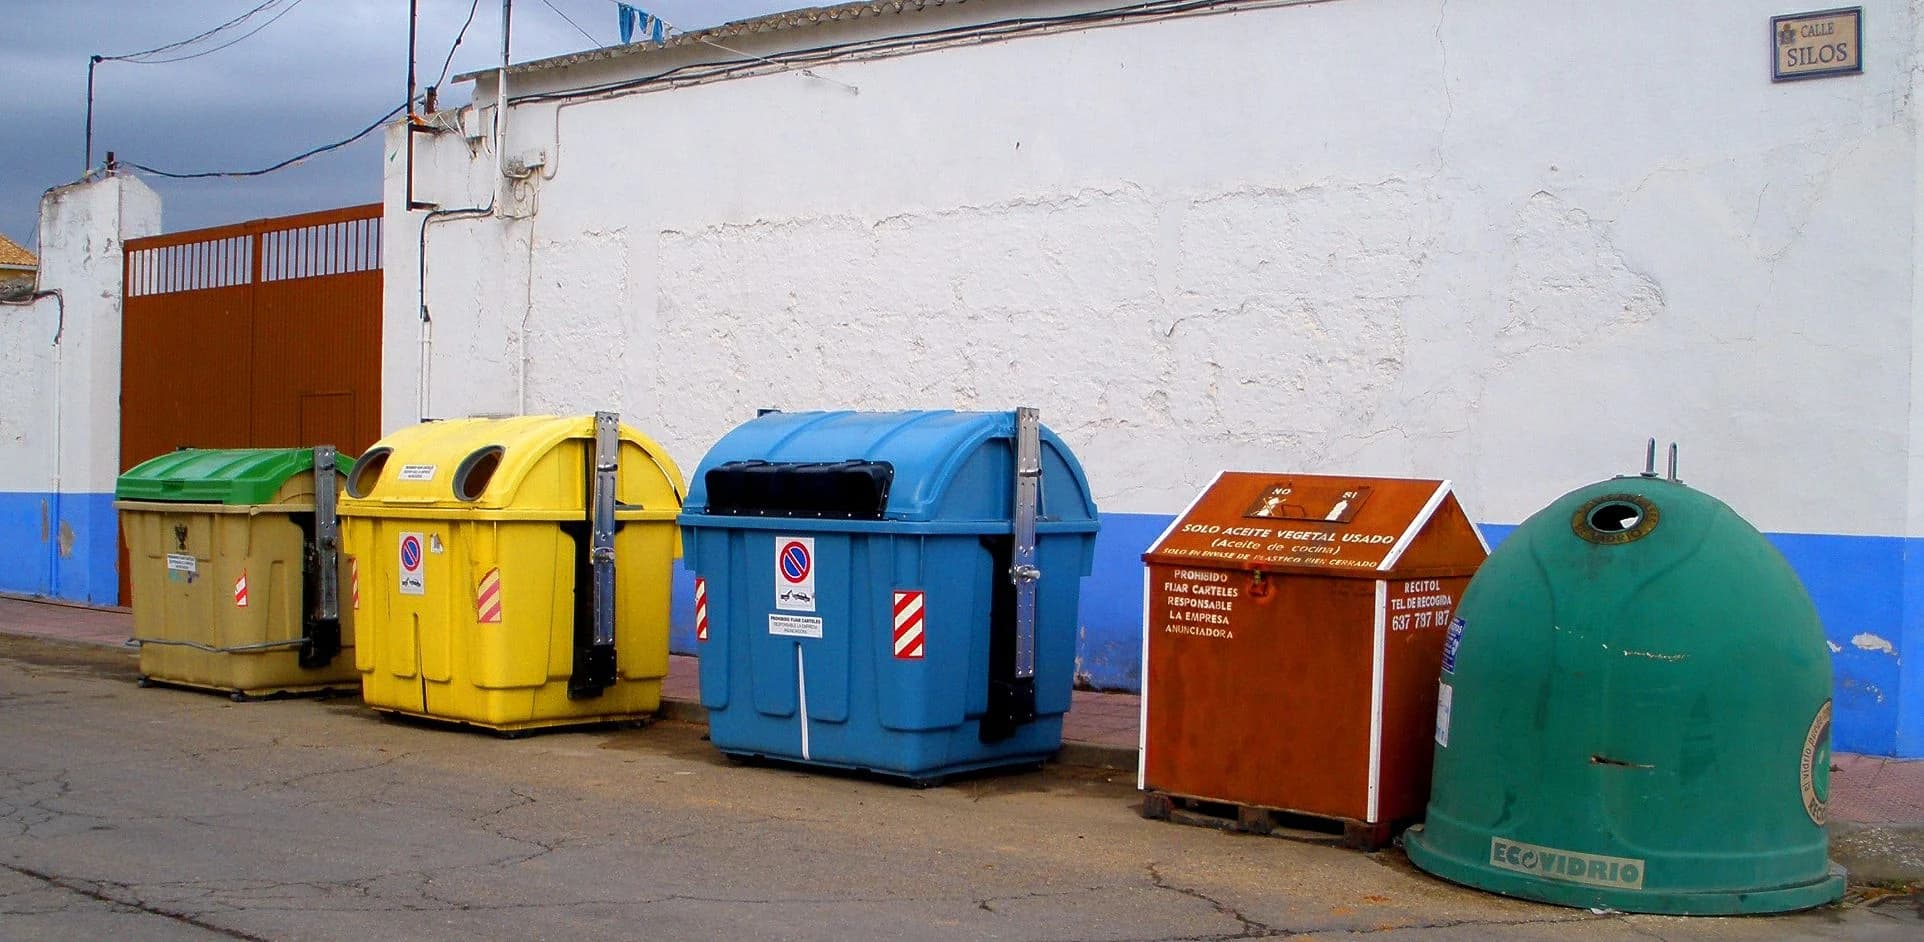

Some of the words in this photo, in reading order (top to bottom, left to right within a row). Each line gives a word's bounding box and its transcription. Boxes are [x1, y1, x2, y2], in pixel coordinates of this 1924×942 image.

[1801, 22, 1835, 38] CALLE
[1787, 42, 1848, 67] SILOS
[1272, 487, 1291, 495] NO
[1342, 491, 1358, 499] SI
[1182, 523, 1220, 534] SOLO
[1221, 527, 1272, 538] ACEITE
[1277, 530, 1336, 542] VEGETAL
[1341, 533, 1395, 544] USADO
[1211, 538, 1261, 550] (Aceite
[1266, 543, 1284, 551] de
[1291, 544, 1341, 556] cocina)
[1201, 550, 1235, 559] ENVASE
[1253, 554, 1302, 563] PLASTICO
[1304, 557, 1326, 565] BIEN
[1328, 559, 1378, 568] CERRADO
[1174, 569, 1228, 583] PROHIBIDO
[1164, 582, 1189, 593] FIJAR
[1192, 585, 1239, 597] CARTELES
[1404, 580, 1440, 593] RECITOL
[1167, 596, 1232, 611] RESPONSABLE
[1407, 597, 1416, 609] DE
[1417, 595, 1452, 608] RECOGIDA
[1169, 610, 1182, 620] LA
[1185, 612, 1230, 625] EMPRESA
[1392, 614, 1411, 631] 637
[1435, 610, 1450, 627] 187
[1165, 624, 1233, 639] ANUNCIADORA
[1494, 842, 1639, 884] ECOVIDRIO
